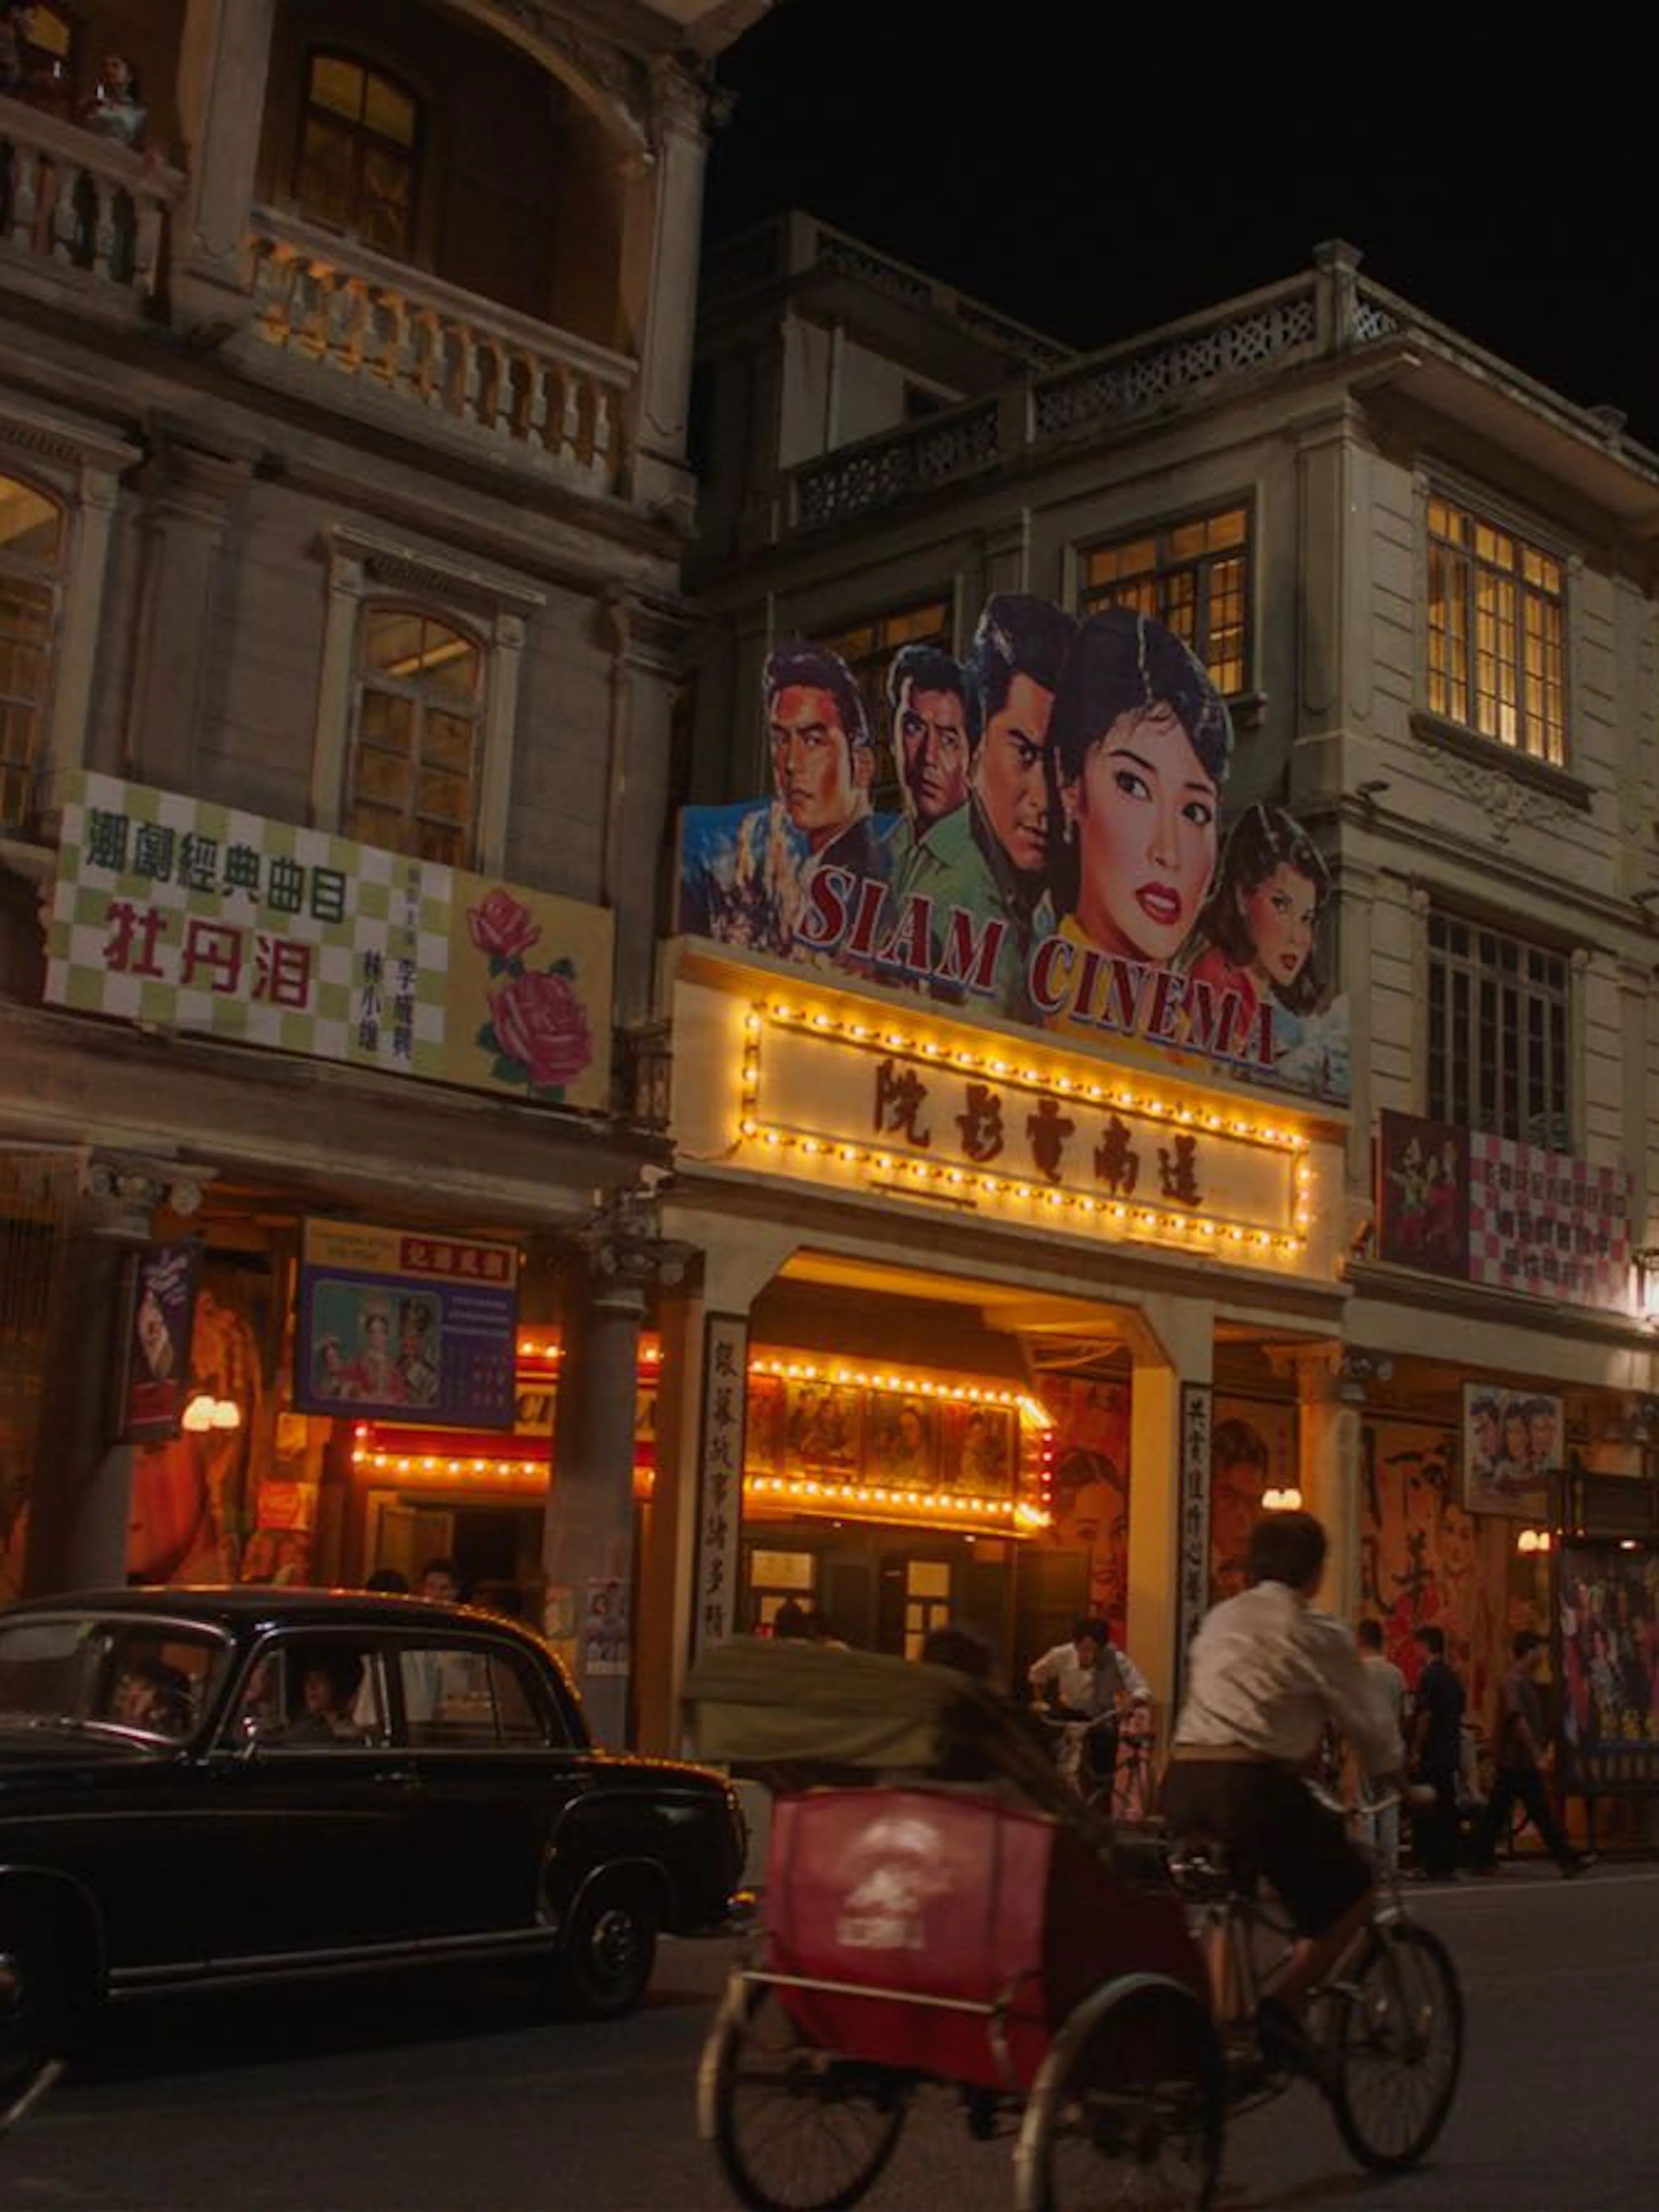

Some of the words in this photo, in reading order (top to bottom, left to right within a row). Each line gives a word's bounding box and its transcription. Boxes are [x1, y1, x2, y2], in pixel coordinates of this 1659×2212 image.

[103, 901, 312, 1009] 牡丹泪
[793, 864, 1007, 995] SIAM
[1028, 934, 1278, 1073] CINEMA
